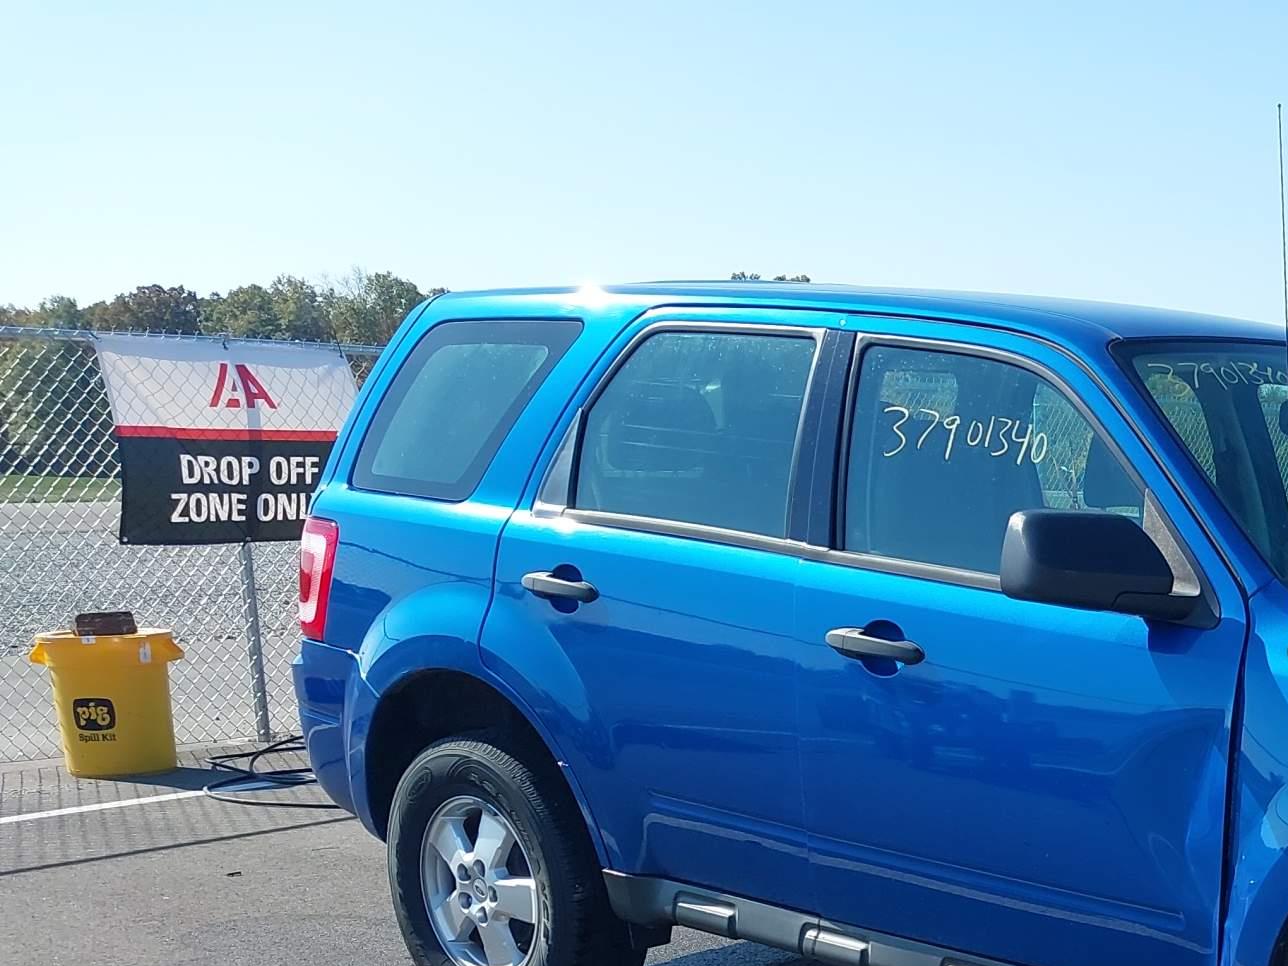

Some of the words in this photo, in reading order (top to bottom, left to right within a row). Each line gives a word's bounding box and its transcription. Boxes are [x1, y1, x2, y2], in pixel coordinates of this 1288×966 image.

[883, 406, 1048, 465] 37901340
[180, 454, 260, 485] DROP
[269, 456, 319, 485] OFF
[171, 493, 247, 522] ZONE
[257, 493, 314, 521] ONL
[78, 734, 100, 743] Spill
[102, 734, 117, 742] Kit
